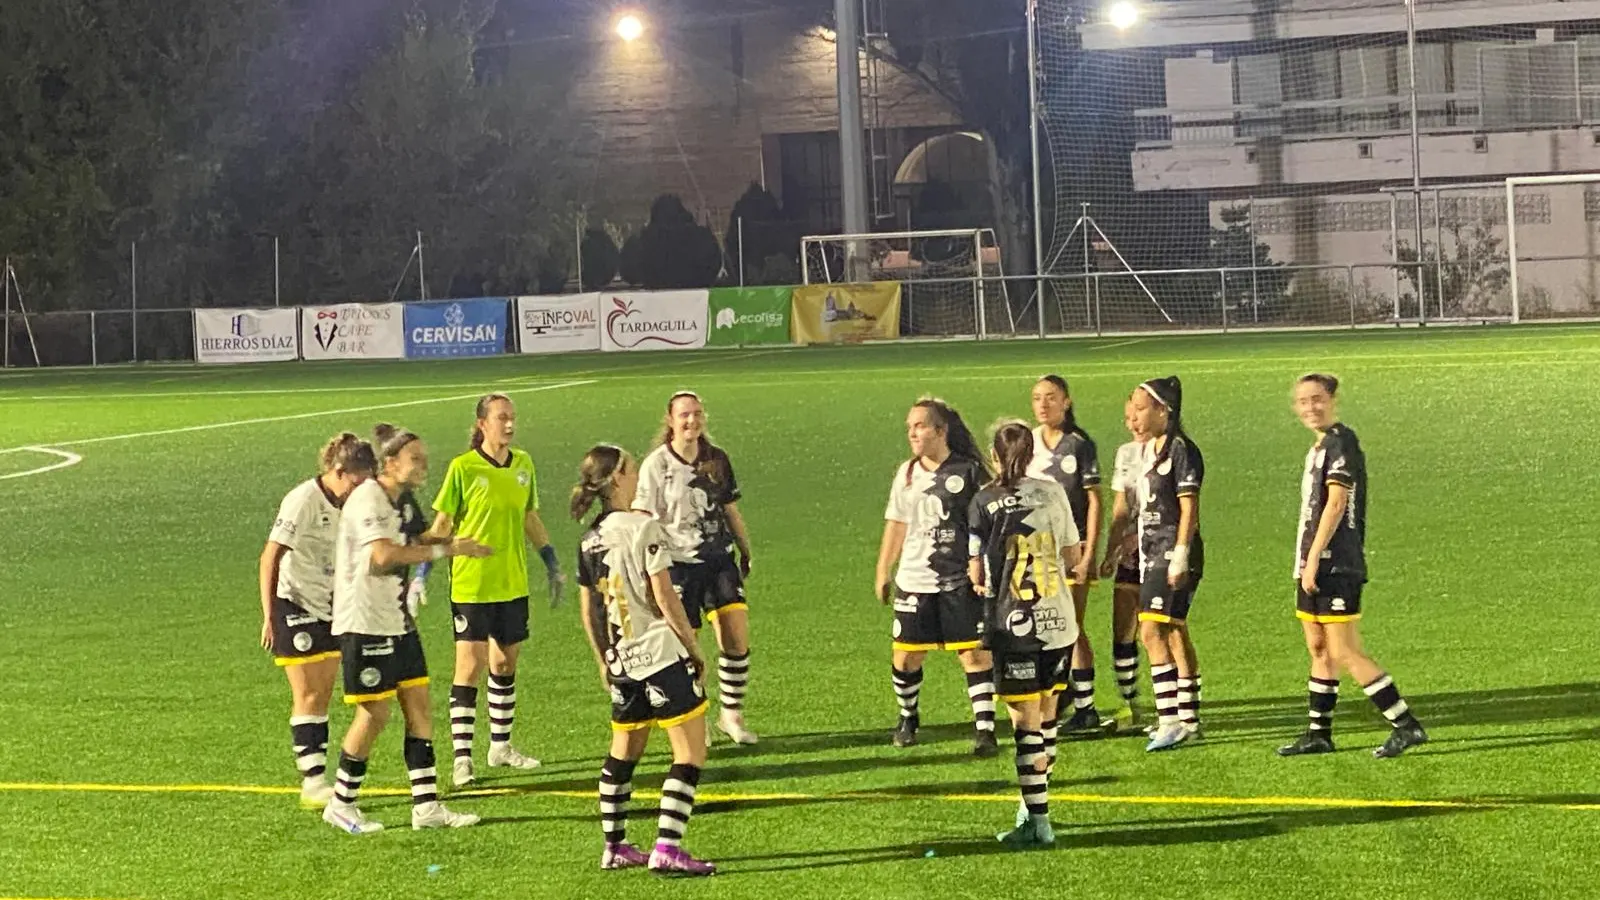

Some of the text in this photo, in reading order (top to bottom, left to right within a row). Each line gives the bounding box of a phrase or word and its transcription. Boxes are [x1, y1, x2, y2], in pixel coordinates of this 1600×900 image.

[543, 309, 597, 325] INFOVAL
[412, 324, 497, 343] CERVISÁN
[619, 320, 698, 333] TARDAGUILA
[201, 334, 294, 350] HIERROS DÍAZ
[1036, 617, 1066, 634] group
